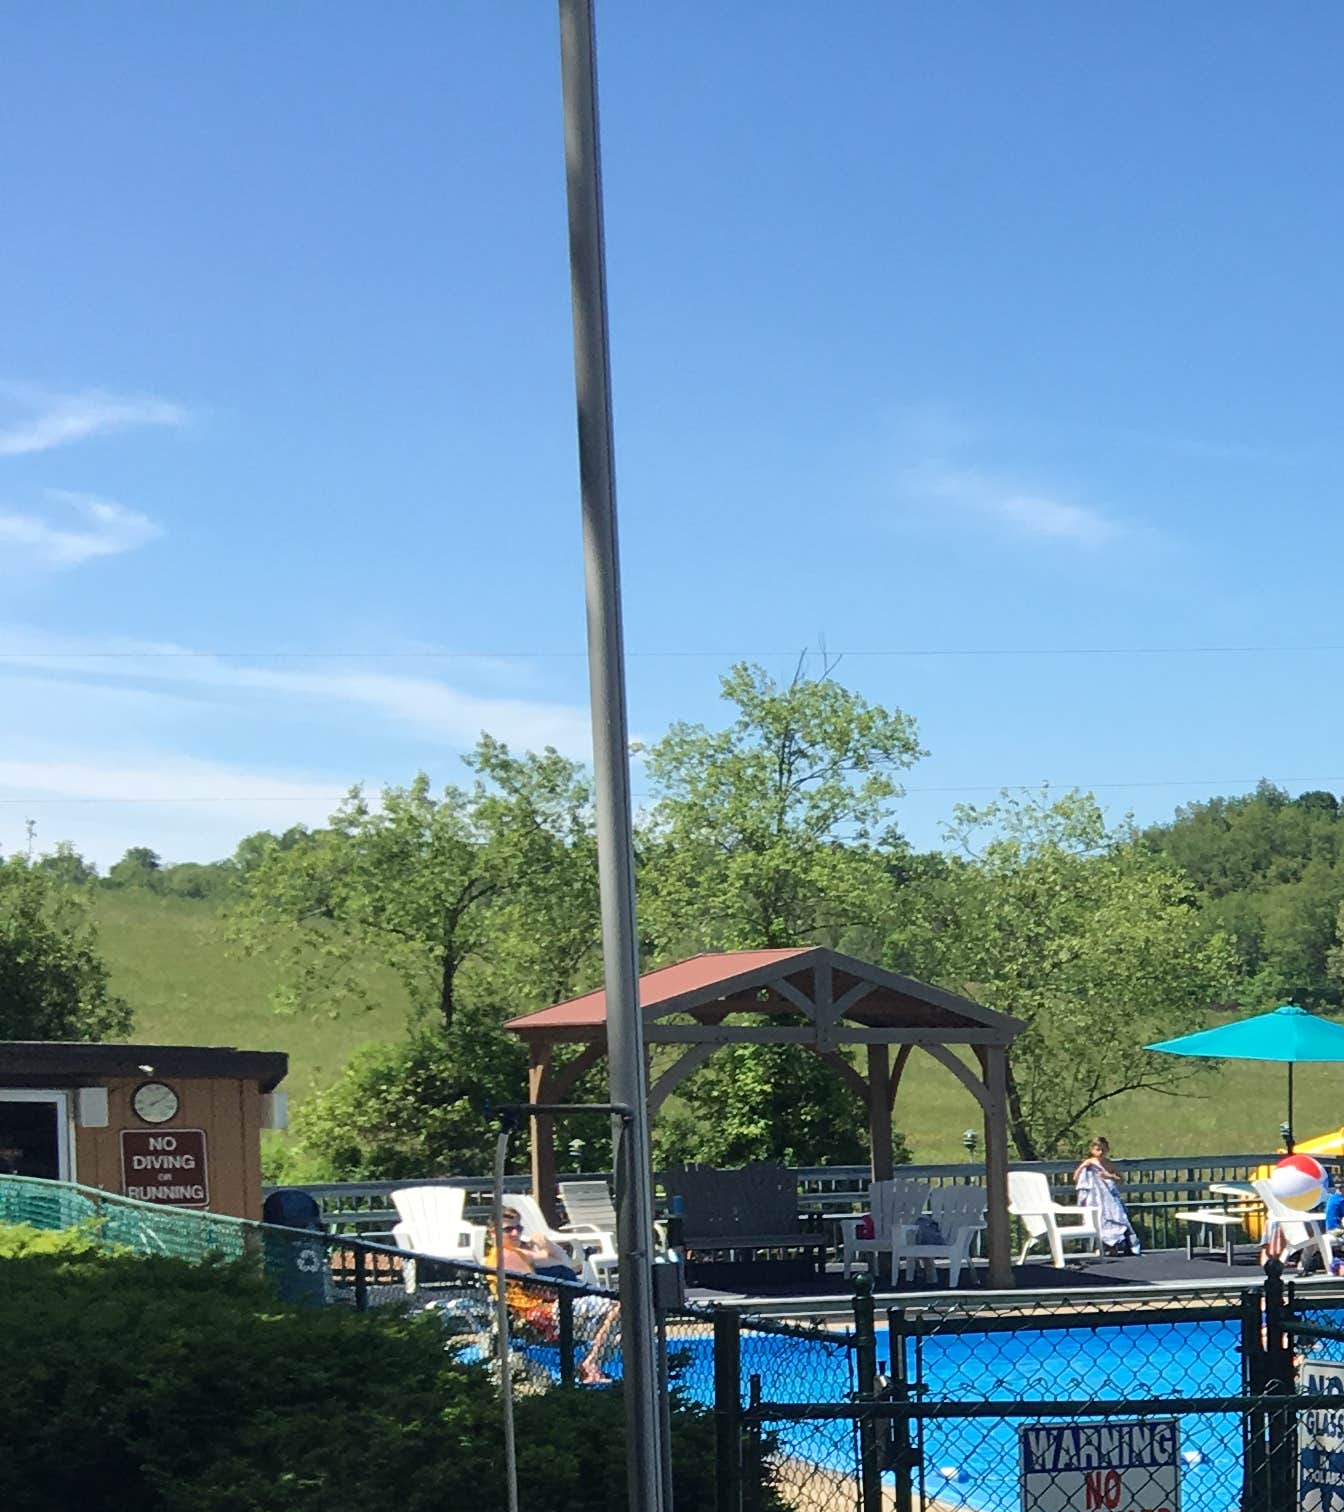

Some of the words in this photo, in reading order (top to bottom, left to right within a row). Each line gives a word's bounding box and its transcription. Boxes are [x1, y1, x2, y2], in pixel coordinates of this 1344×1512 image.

[149, 1137, 176, 1151] NO
[132, 1155, 195, 1170] DIVING
[158, 1173, 172, 1182] OR
[128, 1185, 204, 1200] RUNNING
[1308, 1373, 1344, 1397] NO
[1306, 1410, 1344, 1439] GLASS
[1028, 1425, 1173, 1470] WARNING
[1085, 1469, 1122, 1510] NO
